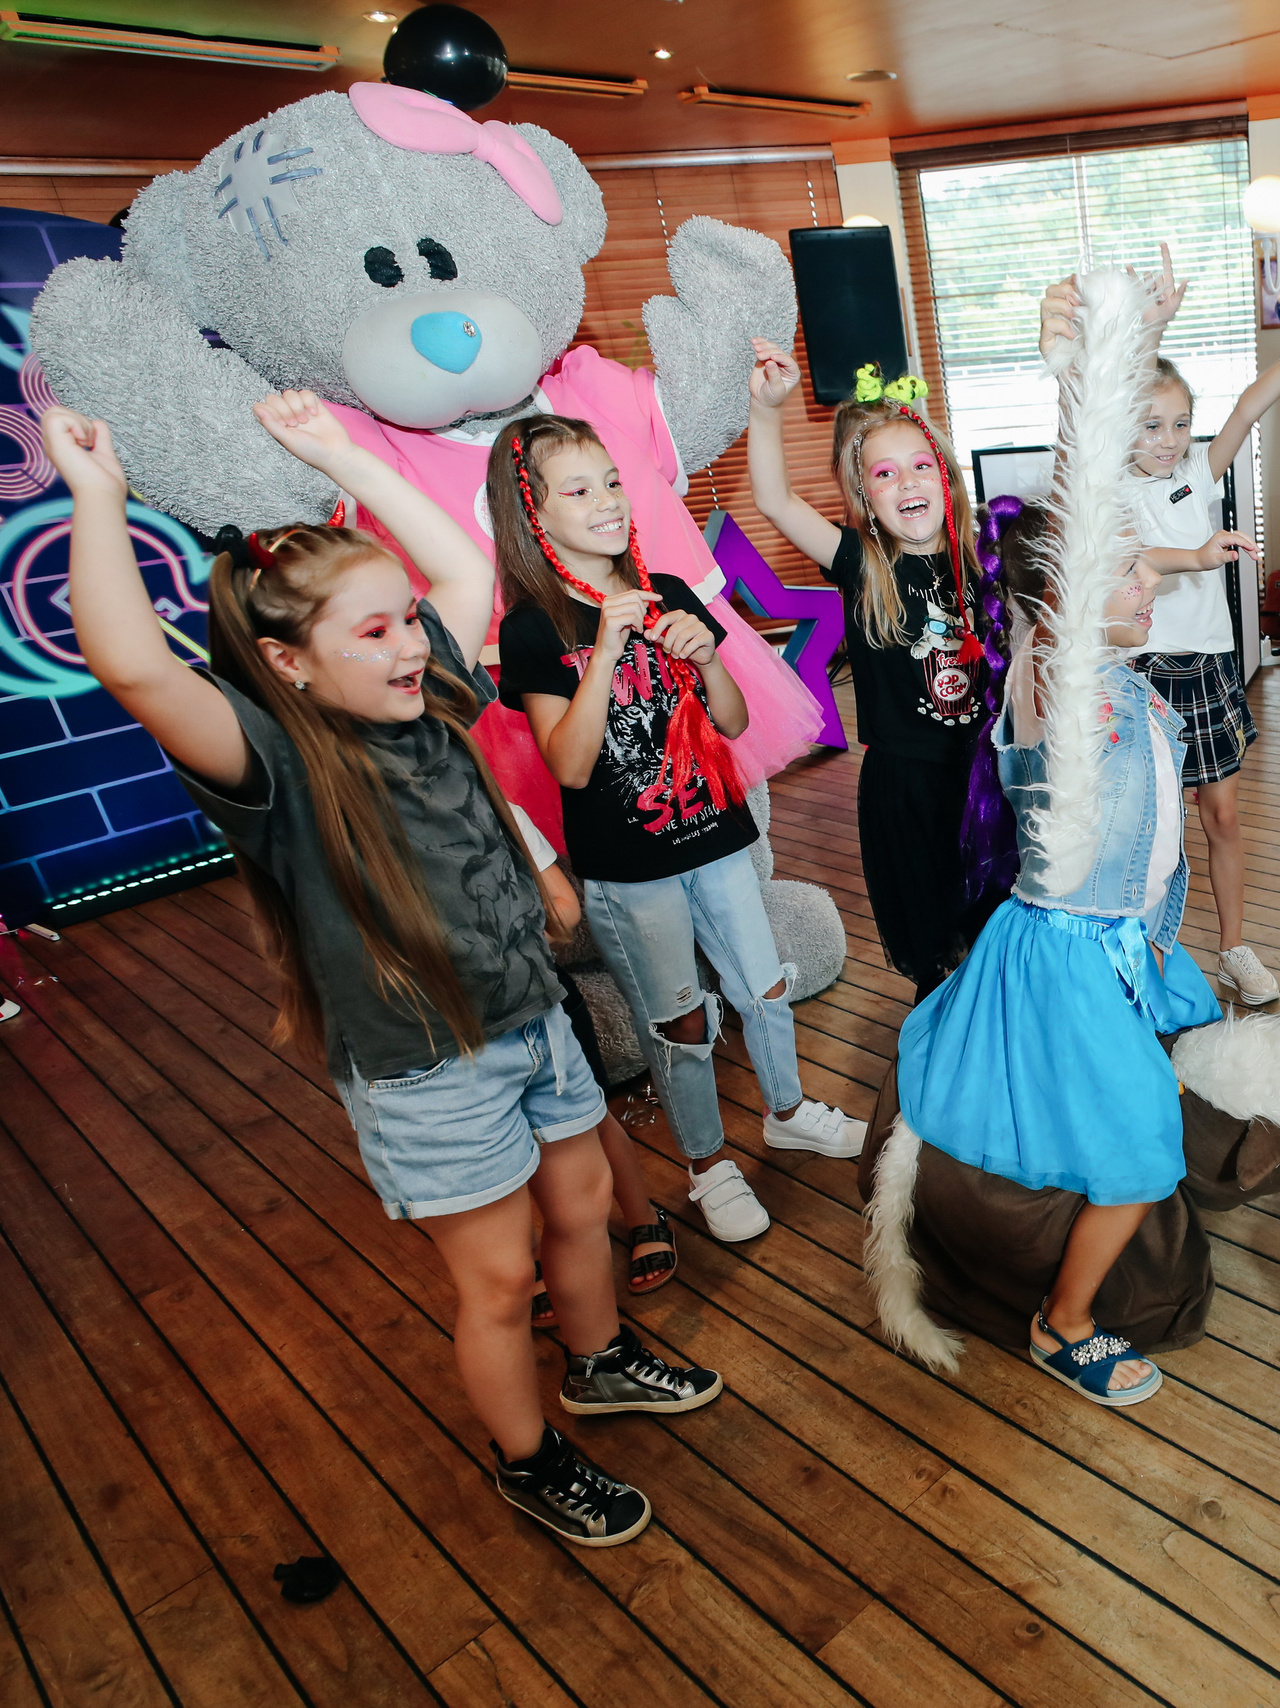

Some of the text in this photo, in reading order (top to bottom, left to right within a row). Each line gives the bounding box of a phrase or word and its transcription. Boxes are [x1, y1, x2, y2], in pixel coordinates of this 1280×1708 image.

[1170, 487, 1187, 502] HEART
[937, 674, 959, 688] POP
[940, 683, 967, 697] CORN
